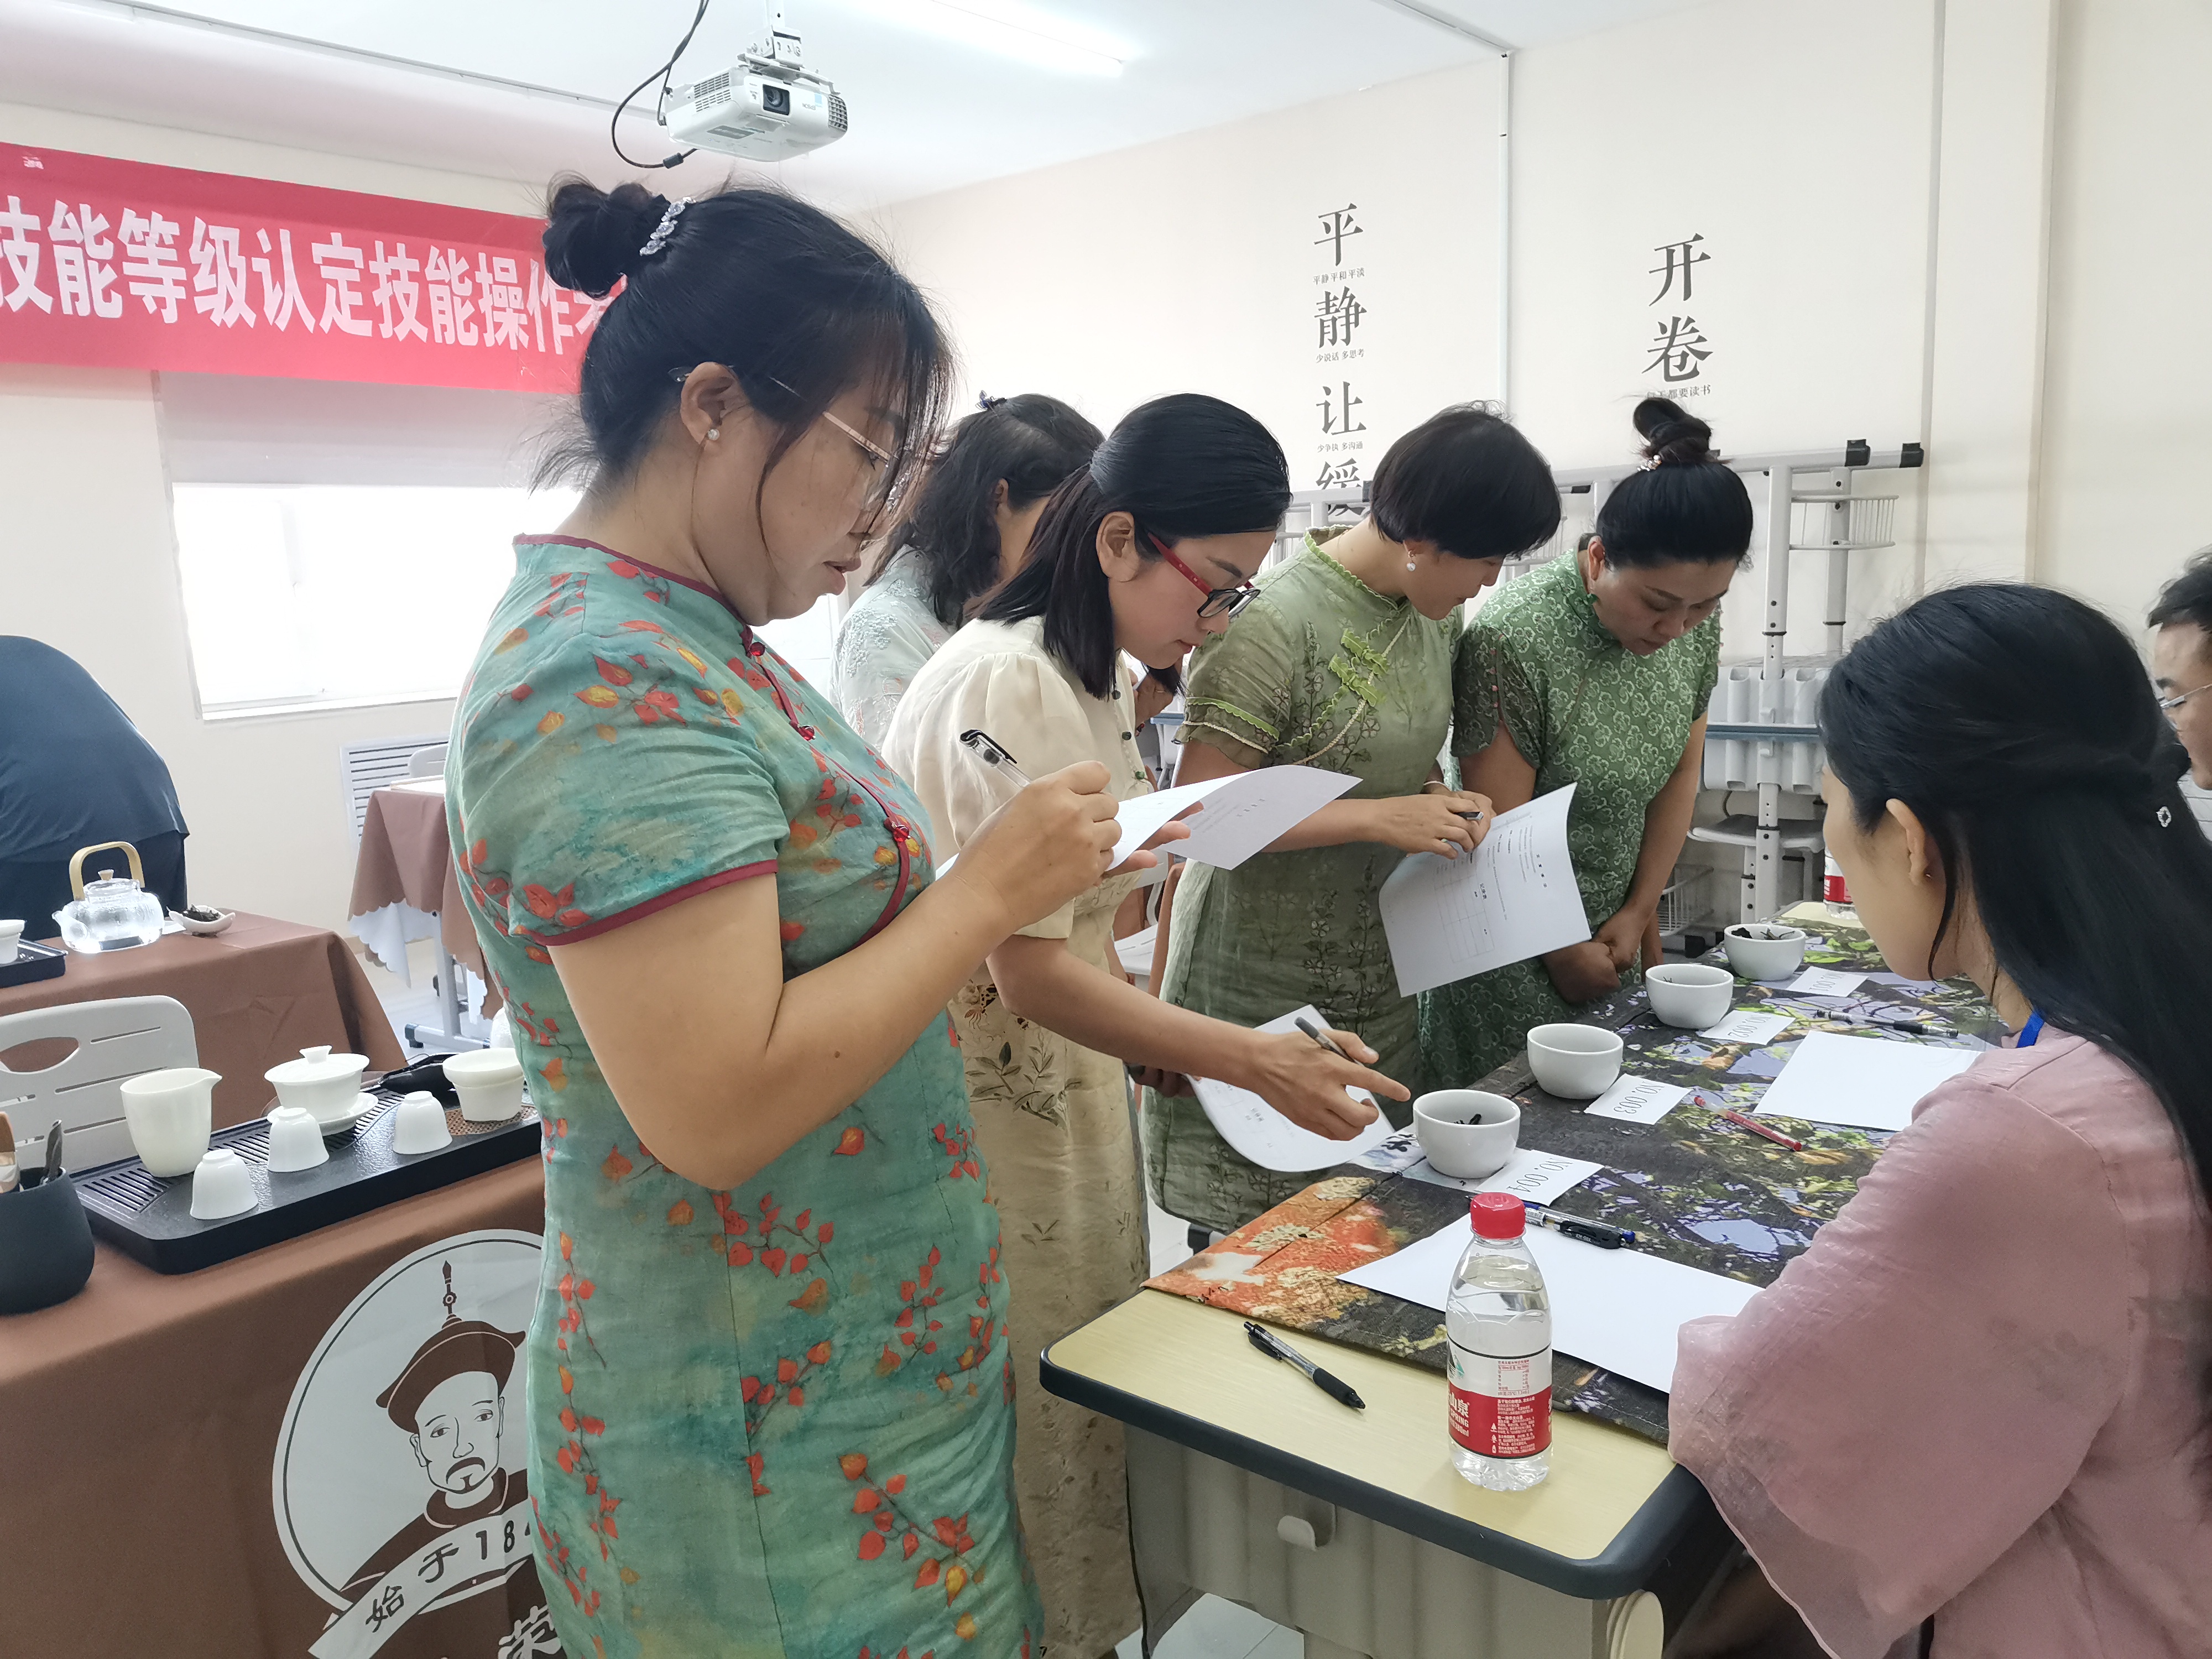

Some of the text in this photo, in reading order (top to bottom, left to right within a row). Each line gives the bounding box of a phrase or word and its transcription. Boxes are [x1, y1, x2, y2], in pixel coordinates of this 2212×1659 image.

[1642, 233, 1713, 382] 开卷
[1450, 1407, 1469, 1428] SPRING
[366, 1520, 531, 1633] 始于18
